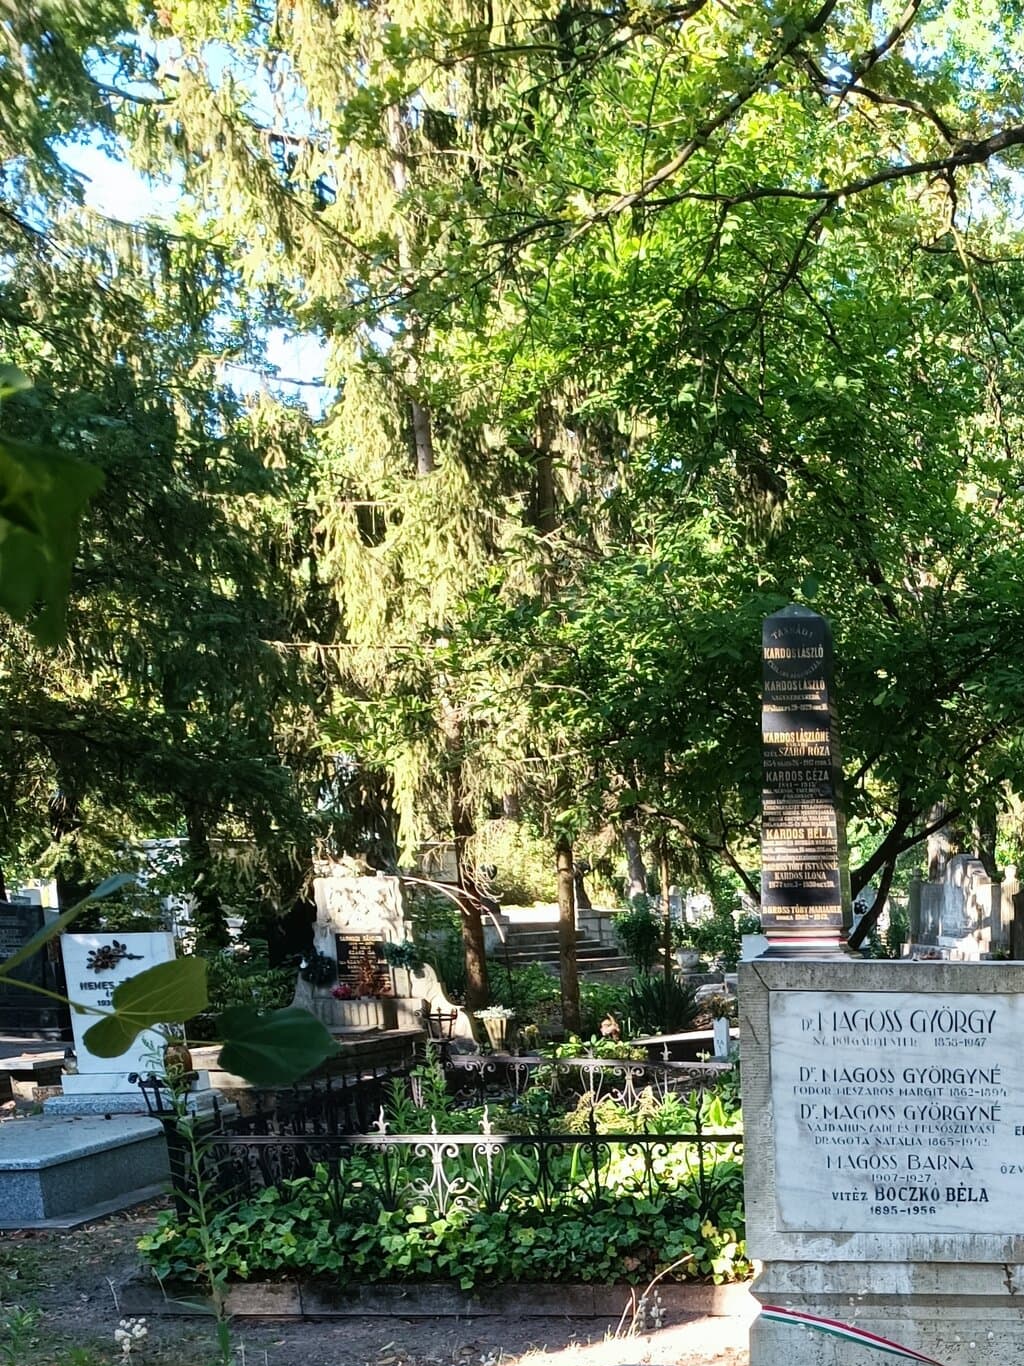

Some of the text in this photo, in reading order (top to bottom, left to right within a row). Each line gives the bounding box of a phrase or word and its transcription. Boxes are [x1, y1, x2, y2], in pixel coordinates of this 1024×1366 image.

[764, 643, 824, 659] KARDOS LÁSZLÓ
[764, 677, 826, 691] KARDOS LÁSZLÓ
[763, 731, 795, 743] KARDOS
[766, 767, 830, 782] KARDOS GÉZA
[766, 828, 805, 839] KARDOS
[910, 1005, 997, 1034] GYÖRGY
[821, 1067, 896, 1084] MAGOSS
[902, 1063, 1001, 1085] GYÖRGYNÉ
[899, 1087, 944, 1097] MARGIT
[823, 1105, 896, 1120] MAGOSS
[903, 1100, 1001, 1122] GYÖRGYNÉ
[827, 1154, 974, 1171] MAGOSS BARNA
[871, 1174, 931, 1183] 1907-1927
[945, 1181, 989, 1203] BÉLA
[870, 1205, 936, 1216] 1895-1956
